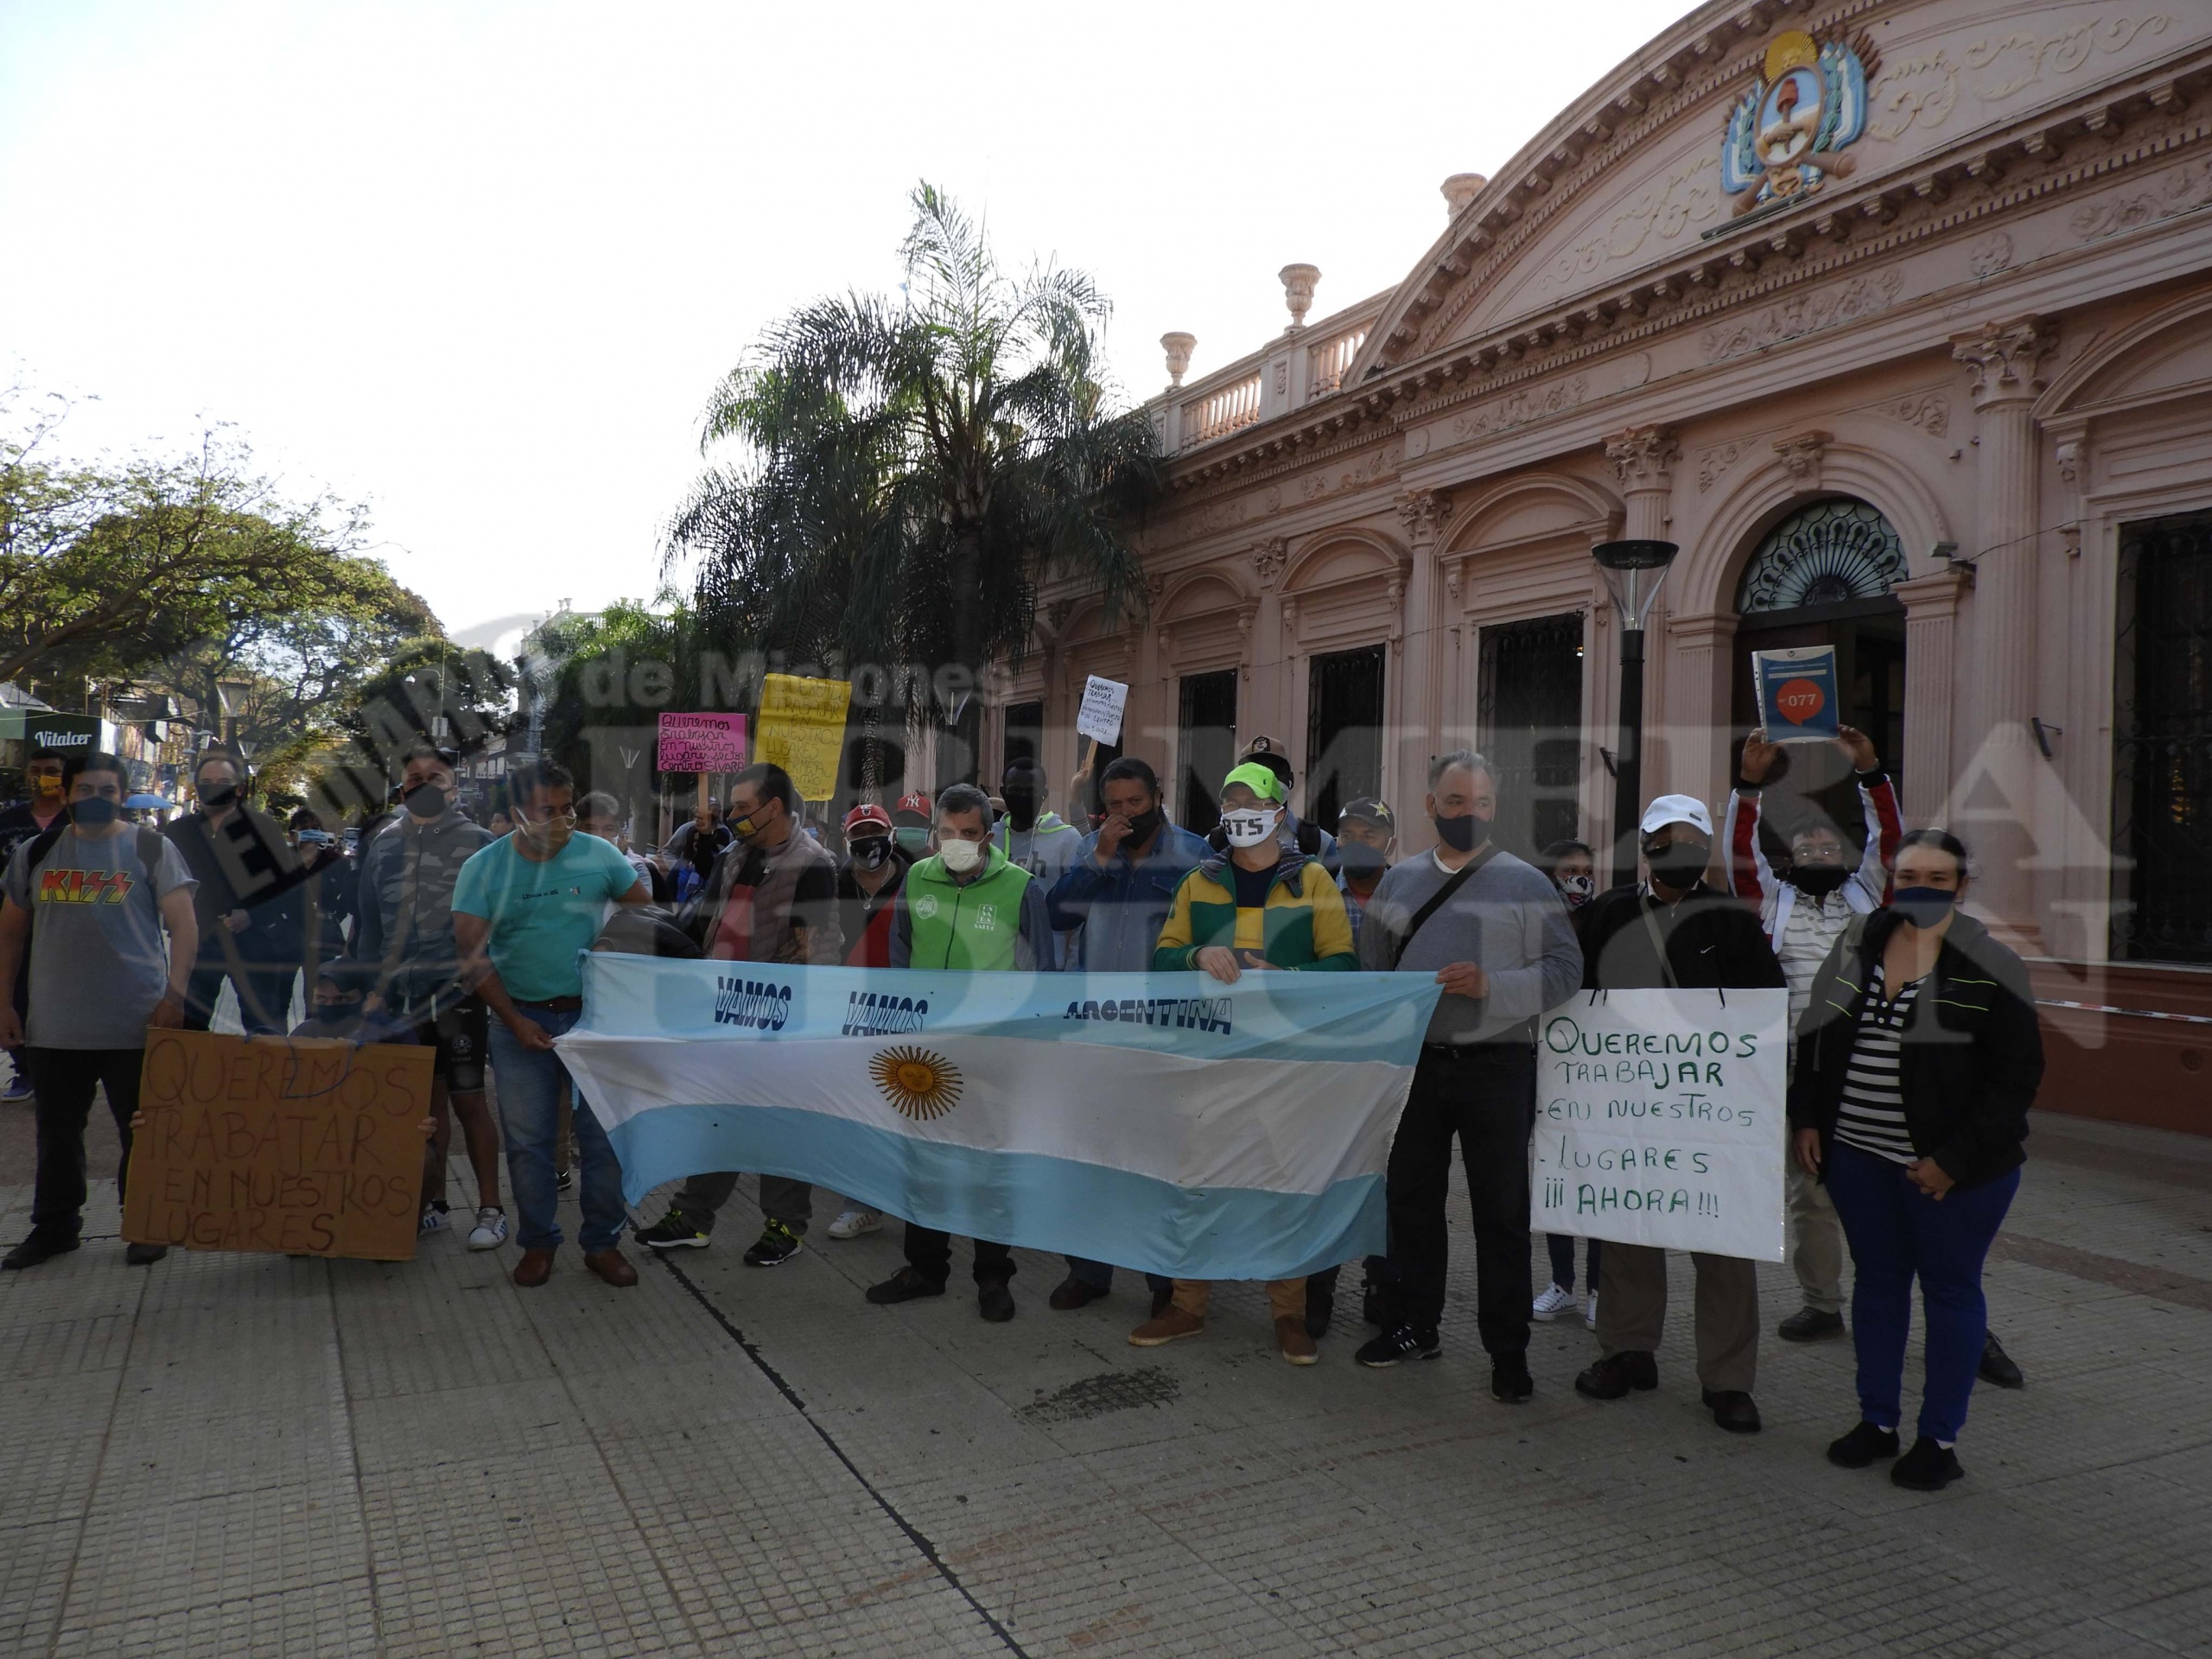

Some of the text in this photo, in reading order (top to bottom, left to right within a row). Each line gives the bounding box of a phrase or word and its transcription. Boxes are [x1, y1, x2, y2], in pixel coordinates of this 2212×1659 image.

[771, 696, 840, 719] TRABAJAR
[1788, 694, 1816, 707] 077
[662, 714, 730, 731] Queremos
[791, 715, 811, 726] EN
[34, 730, 92, 748] Vitalcer
[906, 795, 919, 808] NY
[1224, 817, 1263, 837] BTS
[40, 868, 136, 906] KISS
[715, 976, 792, 1032] VAMOS
[842, 990, 929, 1037] VAMOS
[1545, 1016, 1758, 1058] QUEREMOS
[147, 1037, 415, 1116] QUEREMOS
[1554, 1059, 1724, 1090] TRABAJAR
[1608, 1093, 1756, 1127] NUESTROS
[139, 1105, 384, 1179] TRABAJAR
[1558, 1135, 1712, 1174] LUGARES
[164, 1169, 414, 1217] EN NUESTROS
[143, 1193, 335, 1251] LUGARES
